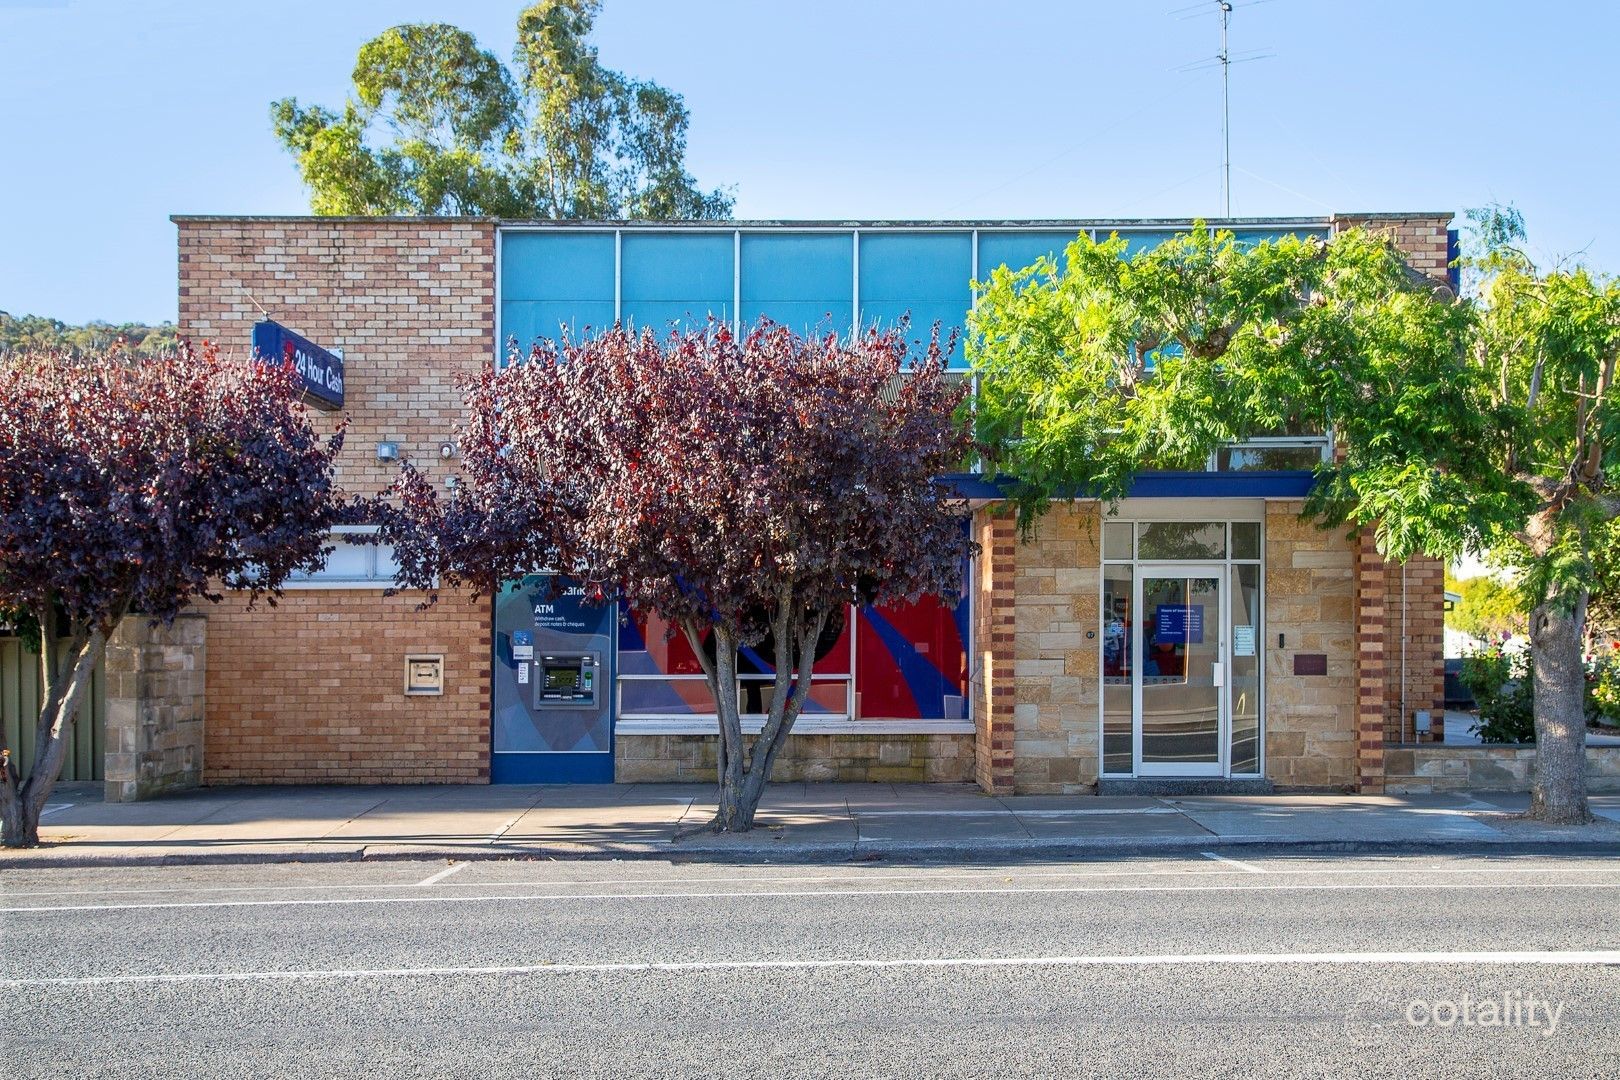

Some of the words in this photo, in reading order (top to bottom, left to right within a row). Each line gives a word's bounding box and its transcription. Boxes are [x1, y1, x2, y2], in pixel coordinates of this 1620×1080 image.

[295, 349, 306, 376] 24
[307, 356, 324, 385] Hour
[326, 366, 343, 394] Cash
[534, 604, 554, 614] ATM
